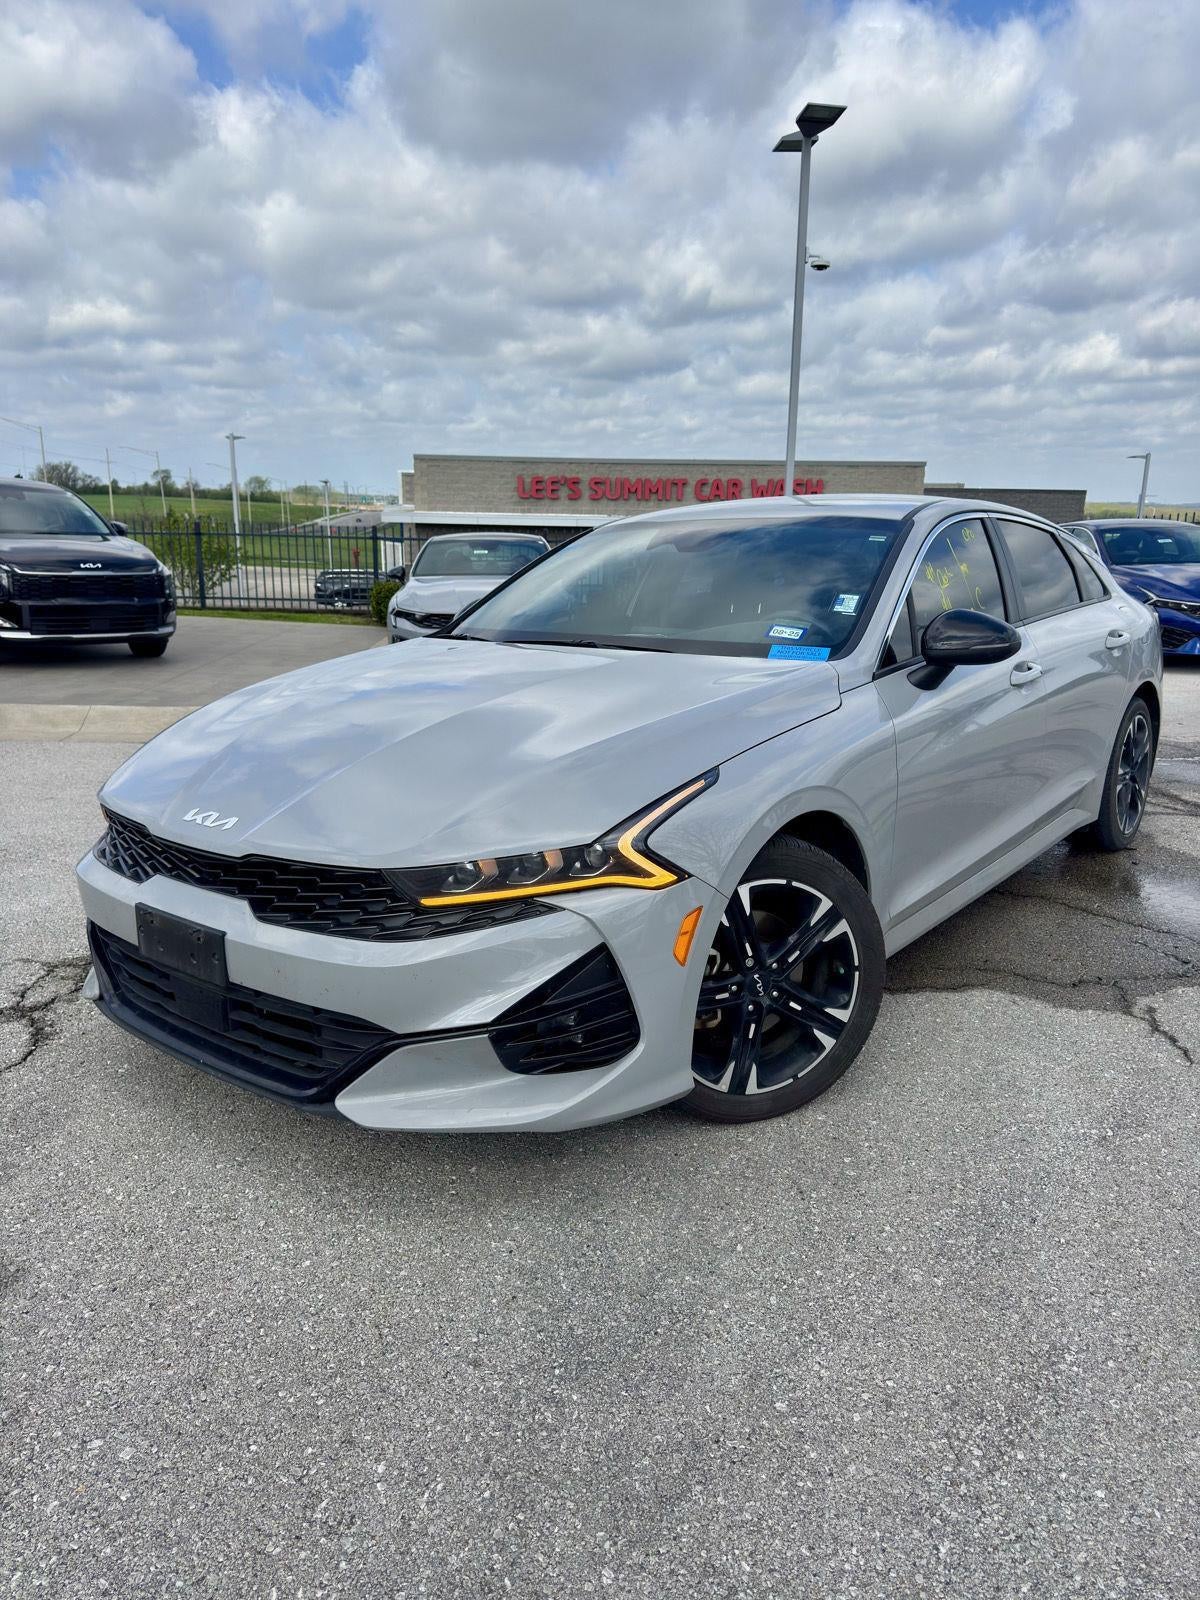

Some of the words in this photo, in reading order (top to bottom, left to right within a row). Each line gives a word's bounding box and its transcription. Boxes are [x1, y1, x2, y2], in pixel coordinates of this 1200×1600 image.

[516, 475, 582, 500] LEE'S
[588, 476, 688, 501] SUMMIT
[694, 478, 743, 502] CAR
[182, 808, 239, 830] KIA
